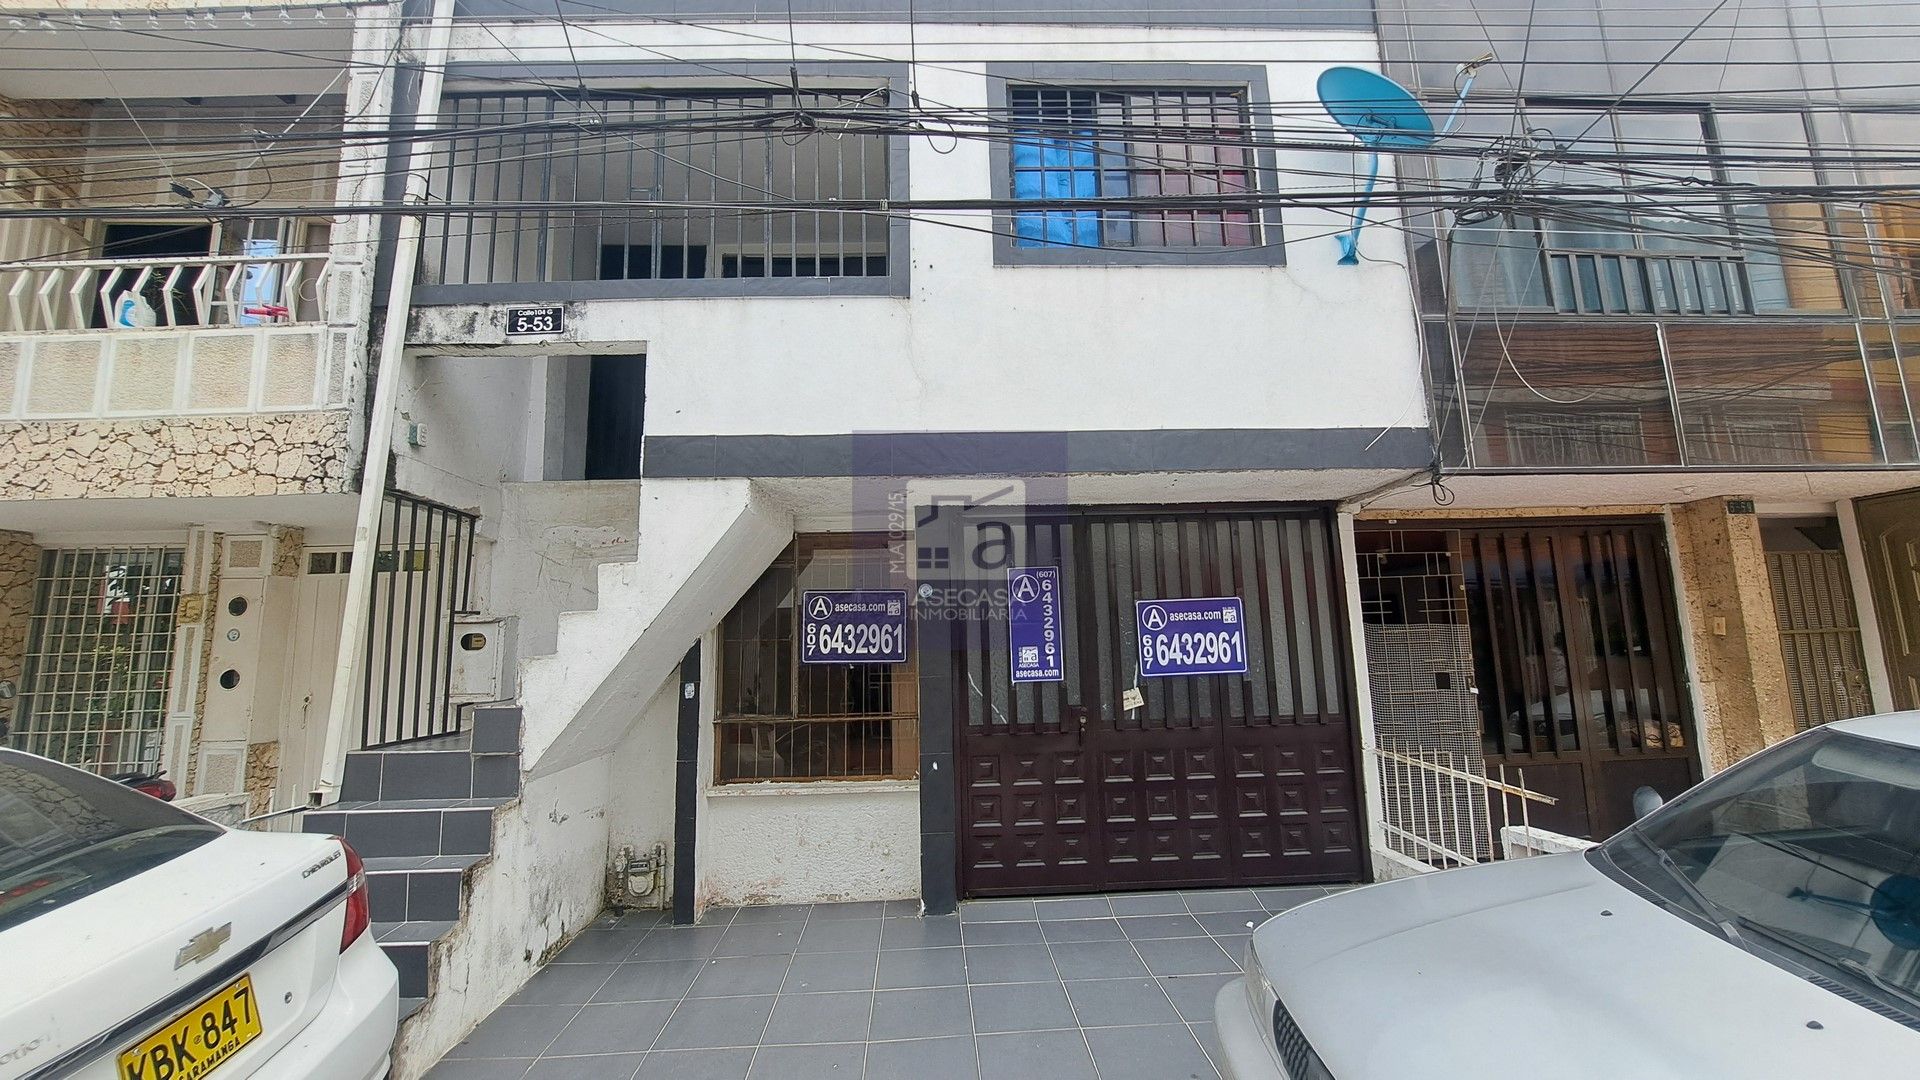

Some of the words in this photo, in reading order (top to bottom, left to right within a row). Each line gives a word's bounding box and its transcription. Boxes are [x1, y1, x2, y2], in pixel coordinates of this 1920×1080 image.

[517, 316, 553, 331] 5-53
[1036, 570, 1056, 578] (607)
[834, 602, 886, 612] asecasa.com
[1169, 610, 1221, 621] asecasa.com
[1041, 580, 1056, 667] 6432961
[807, 623, 816, 656] 607
[819, 624, 902, 654] 6432961
[1142, 634, 1154, 669] 607
[1156, 631, 1242, 666] 6432961
[1016, 669, 1059, 677] asecasa.com
[127, 1026, 197, 1080] KBK
[201, 986, 251, 1049] 847
